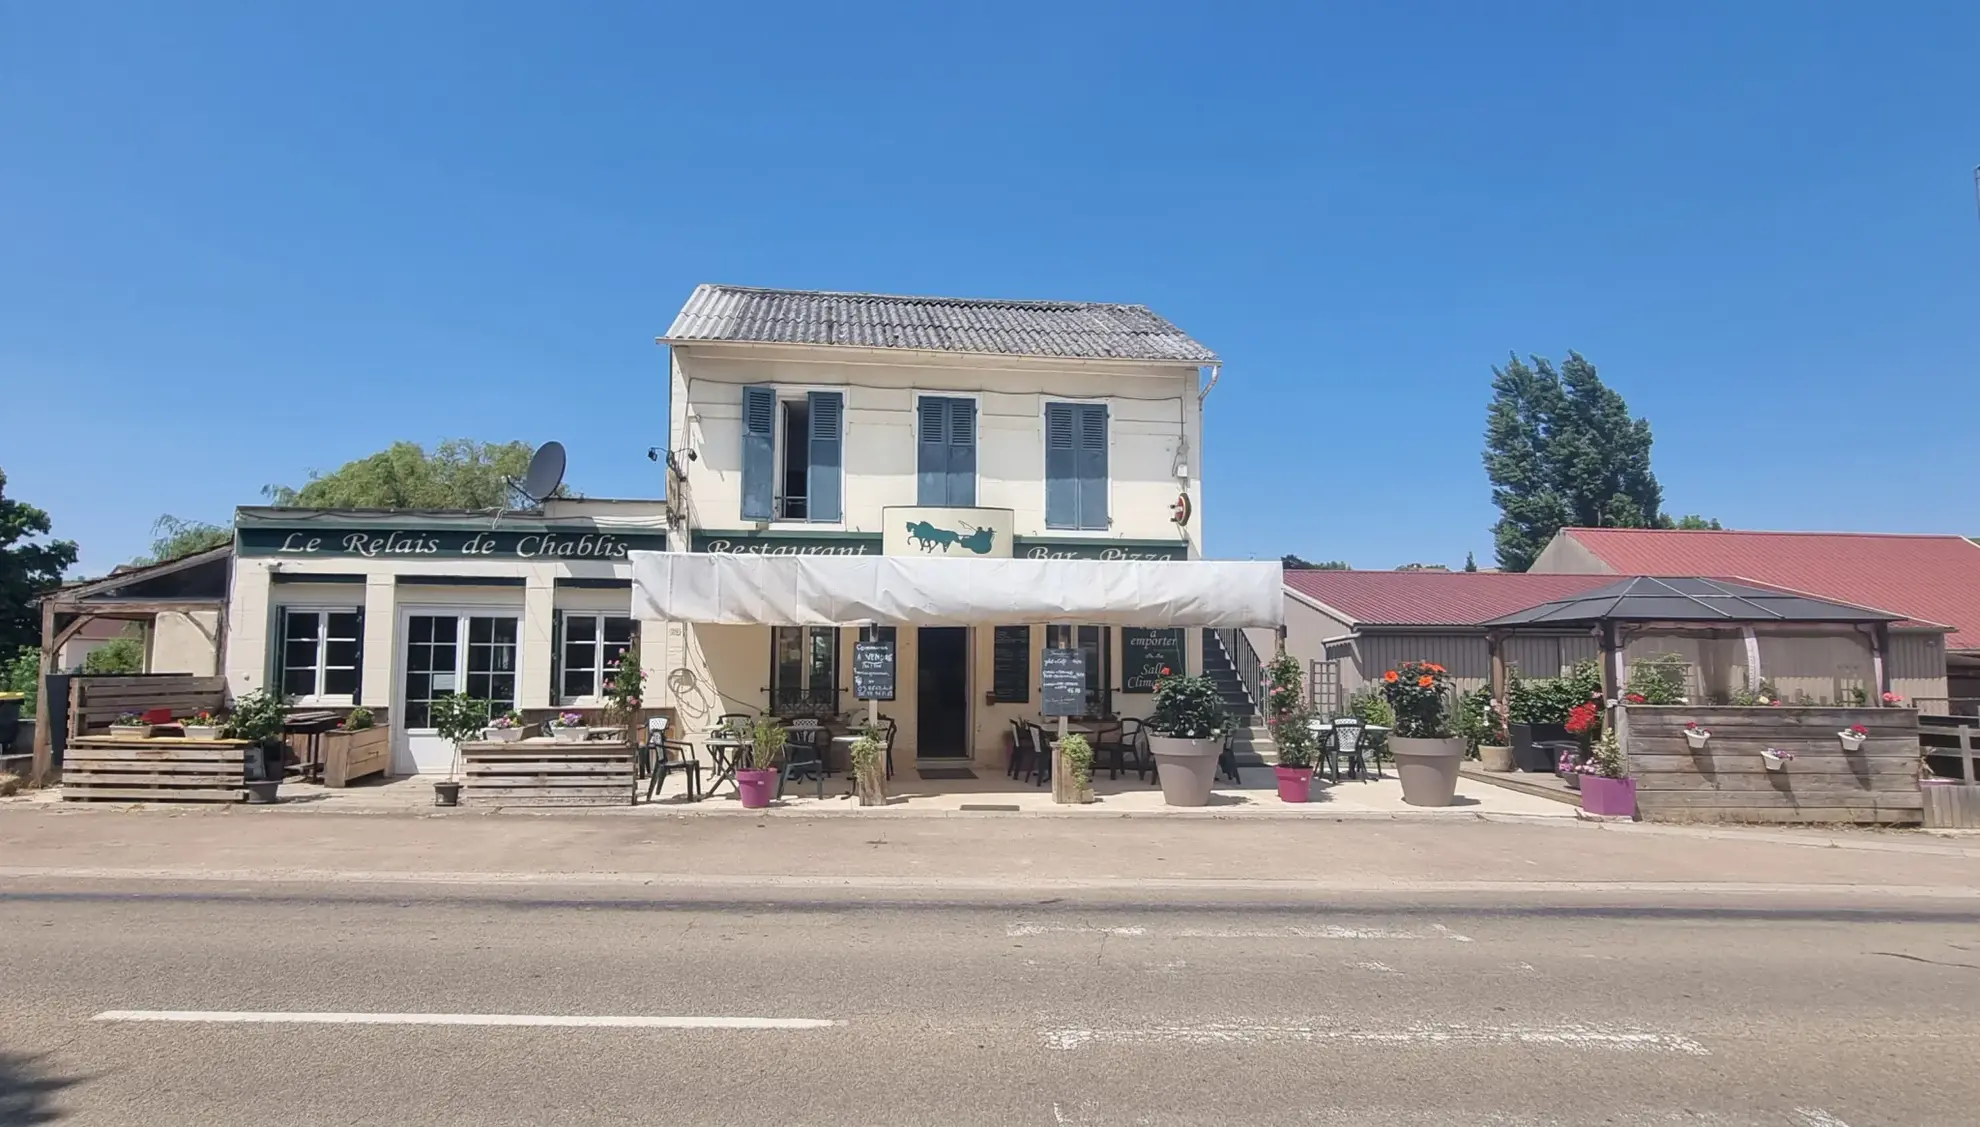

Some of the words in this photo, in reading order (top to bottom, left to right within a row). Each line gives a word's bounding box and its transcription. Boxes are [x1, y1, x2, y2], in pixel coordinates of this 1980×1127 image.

[278, 532, 321, 553] Le
[343, 531, 440, 557] Relais
[461, 532, 496, 554] de
[516, 533, 629, 558] Chablis
[707, 539, 868, 556] Restaurant
[1130, 636, 1177, 649] emporter
[1140, 662, 1166, 676] Sall
